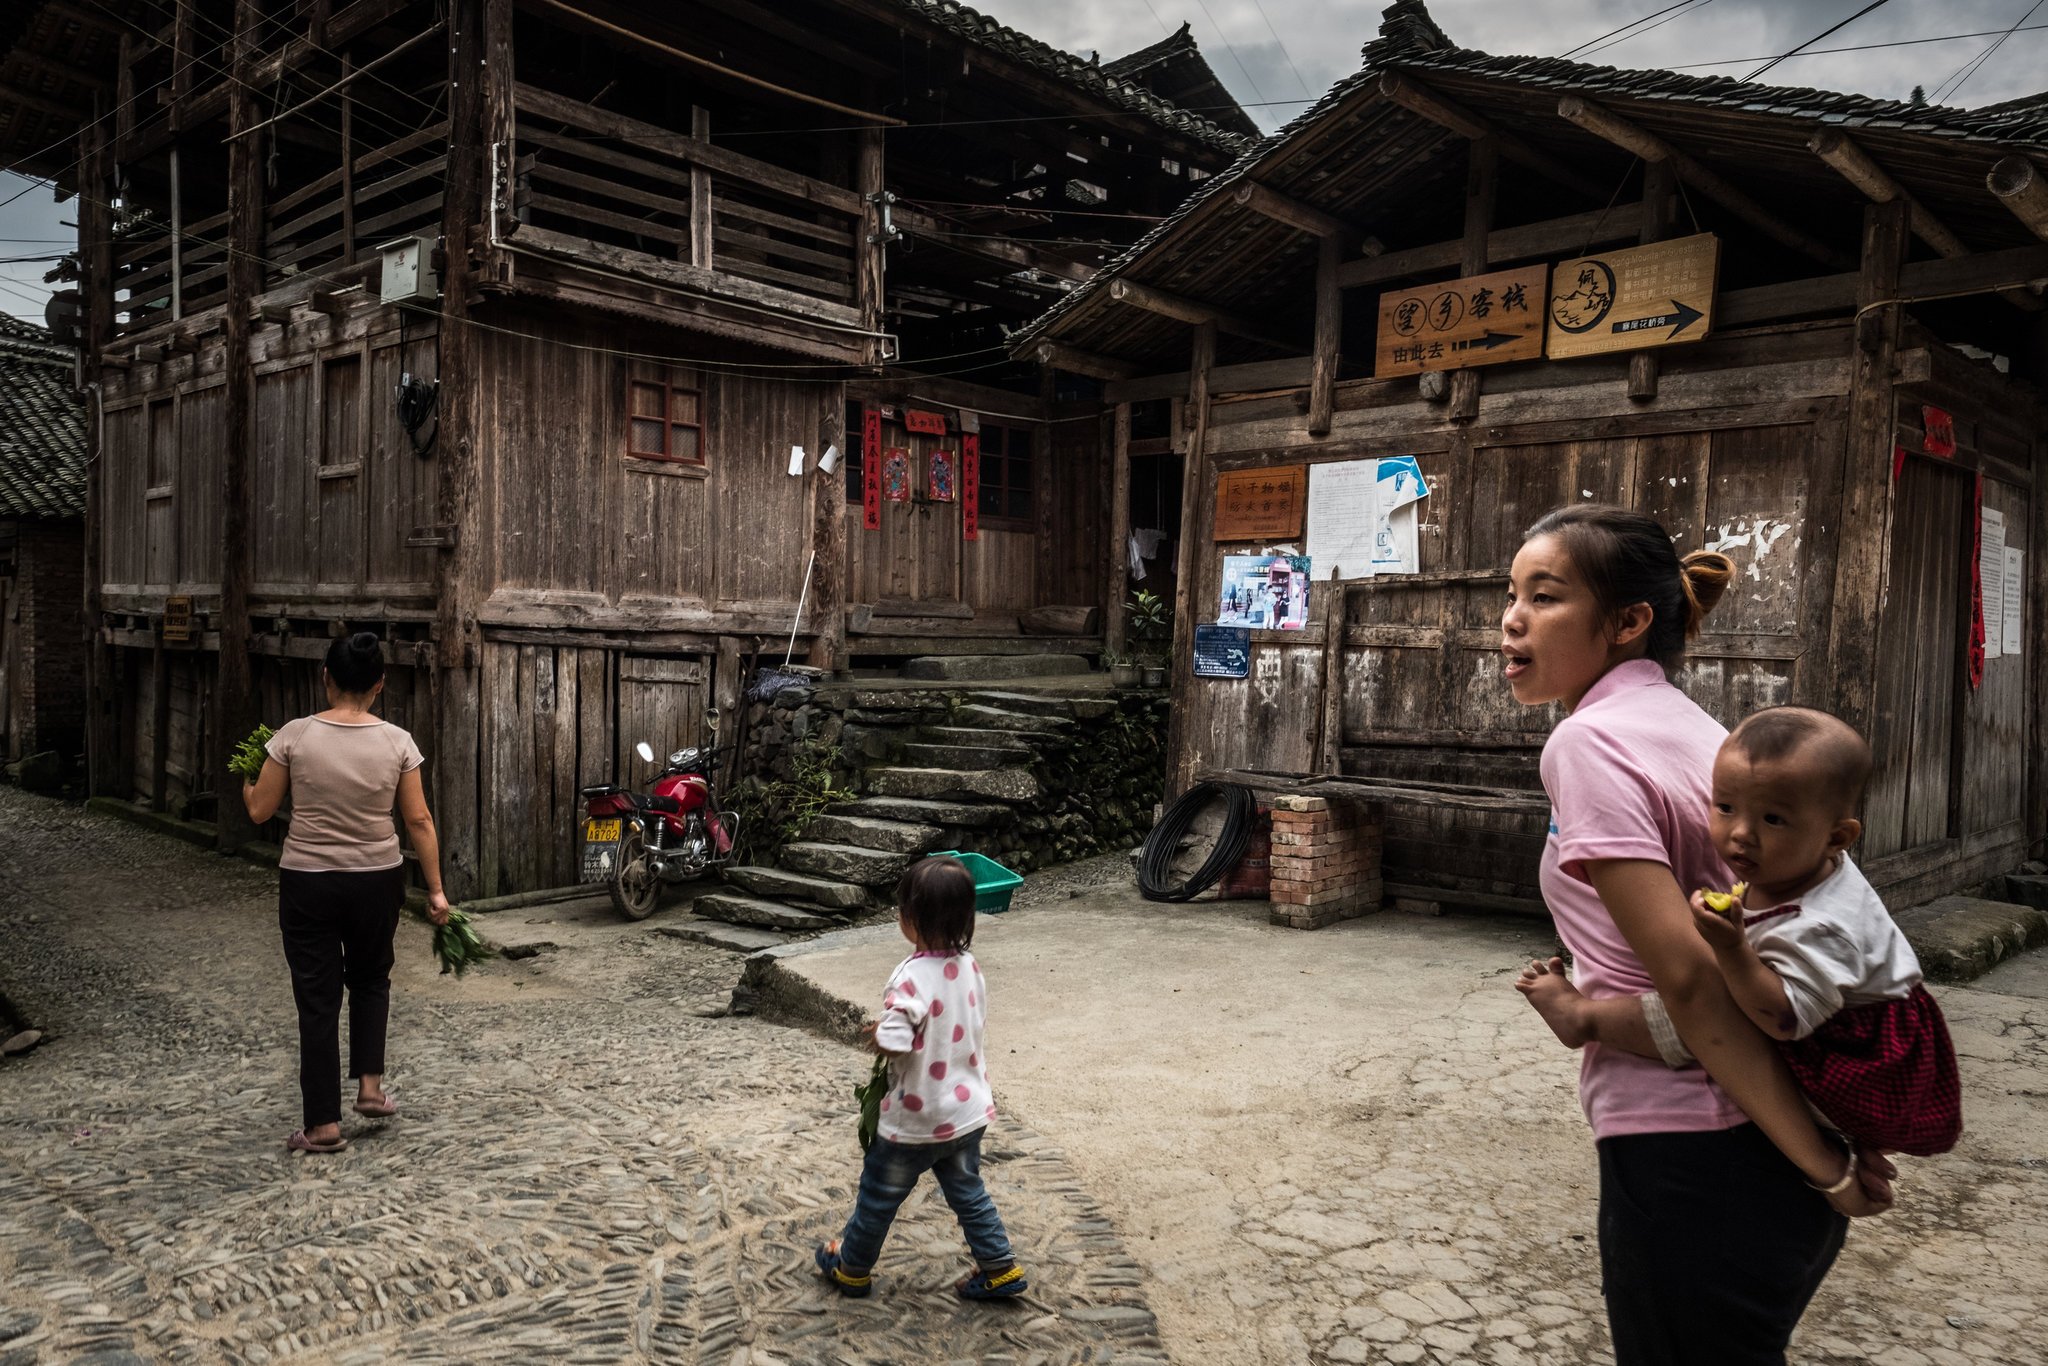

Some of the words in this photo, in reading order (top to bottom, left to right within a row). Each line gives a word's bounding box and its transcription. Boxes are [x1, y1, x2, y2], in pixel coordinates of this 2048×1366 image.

[1397, 282, 1529, 332] 望乡客栈
[1394, 341, 1445, 364] 由此去
[588, 829, 618, 841] A8782
